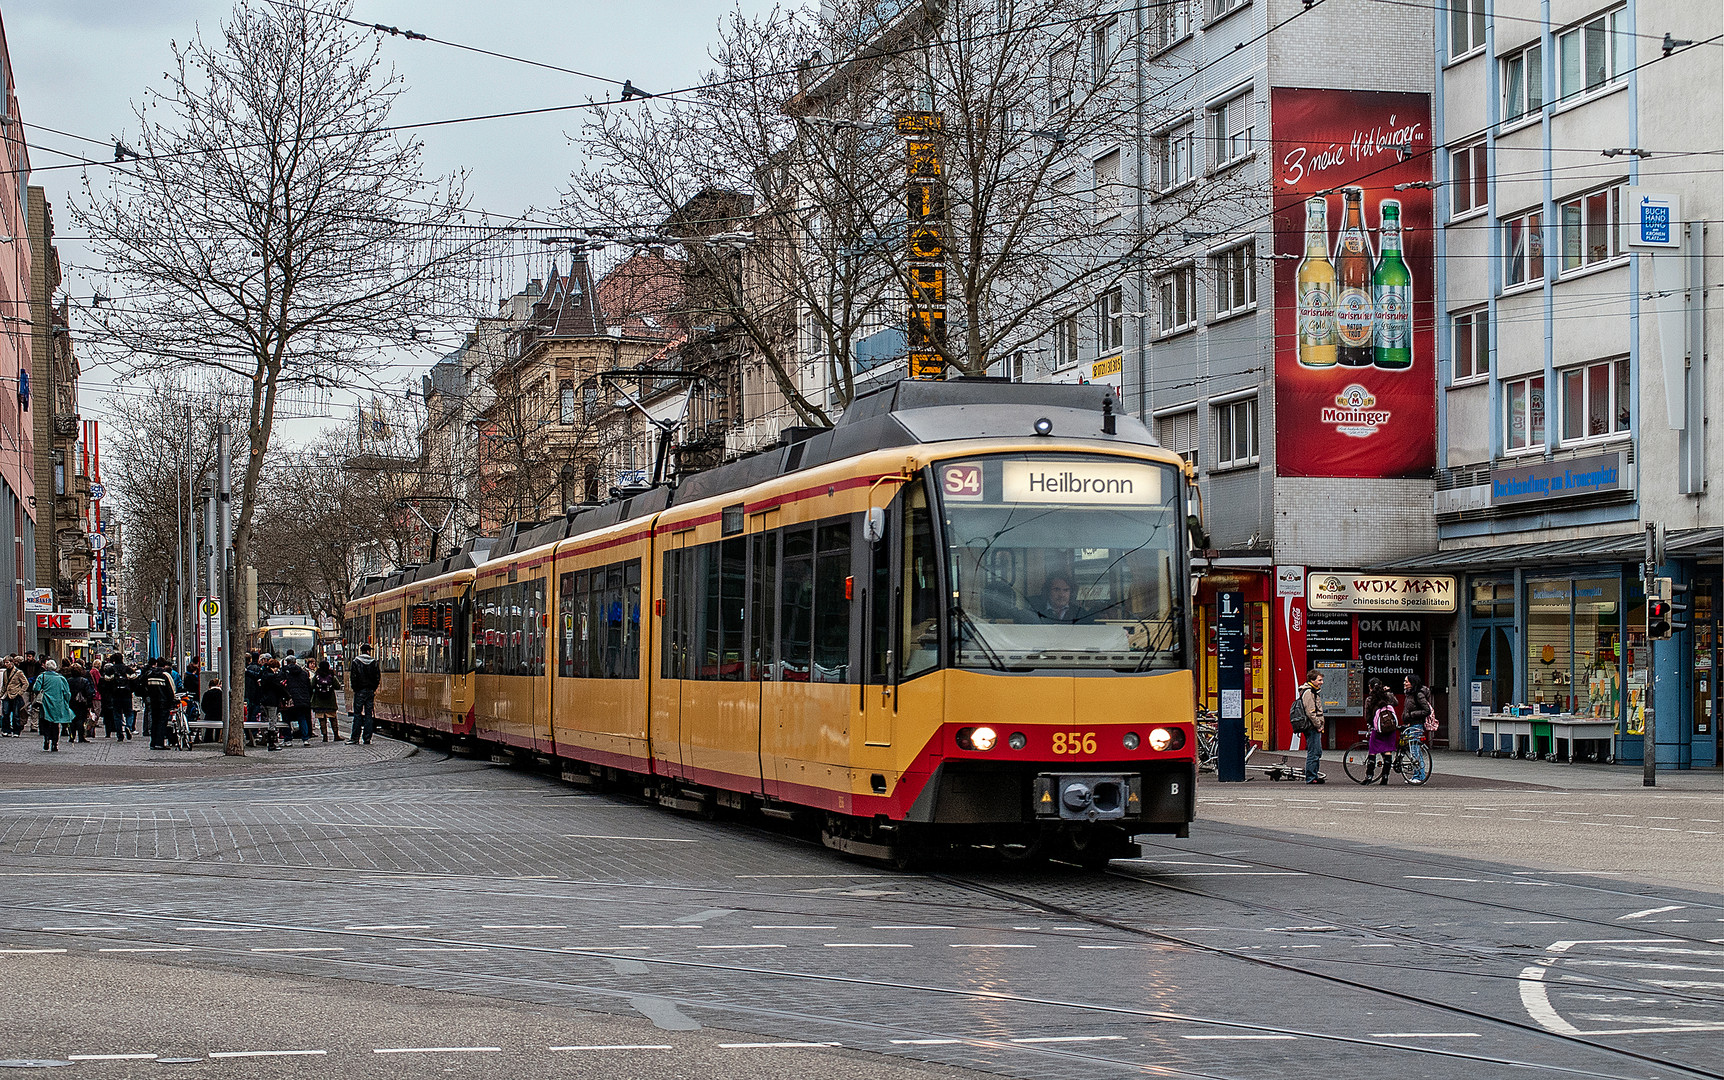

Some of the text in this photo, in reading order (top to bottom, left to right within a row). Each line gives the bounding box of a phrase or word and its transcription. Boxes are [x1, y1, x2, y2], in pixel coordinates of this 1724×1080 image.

[1284, 148, 1306, 185] 3
[1301, 308, 1334, 317] Karlsruher
[1338, 312, 1372, 320] Karlsruher
[1375, 312, 1408, 320] Karlsruher
[1308, 320, 1326, 330] Gold
[1323, 408, 1389, 425] Moninger
[945, 468, 980, 492] S4
[1029, 472, 1133, 494] Heilbronn
[1493, 465, 1617, 498] Buchhandlung am Kronenplatz
[1353, 579, 1449, 594] WOK MAN
[1316, 593, 1348, 601] Moninger
[1401, 598, 1450, 606] Spezialitäten
[1358, 620, 1421, 631] OK MAN
[1359, 641, 1382, 649] jeder
[1052, 732, 1097, 754] 856
[1170, 783, 1179, 795] B
